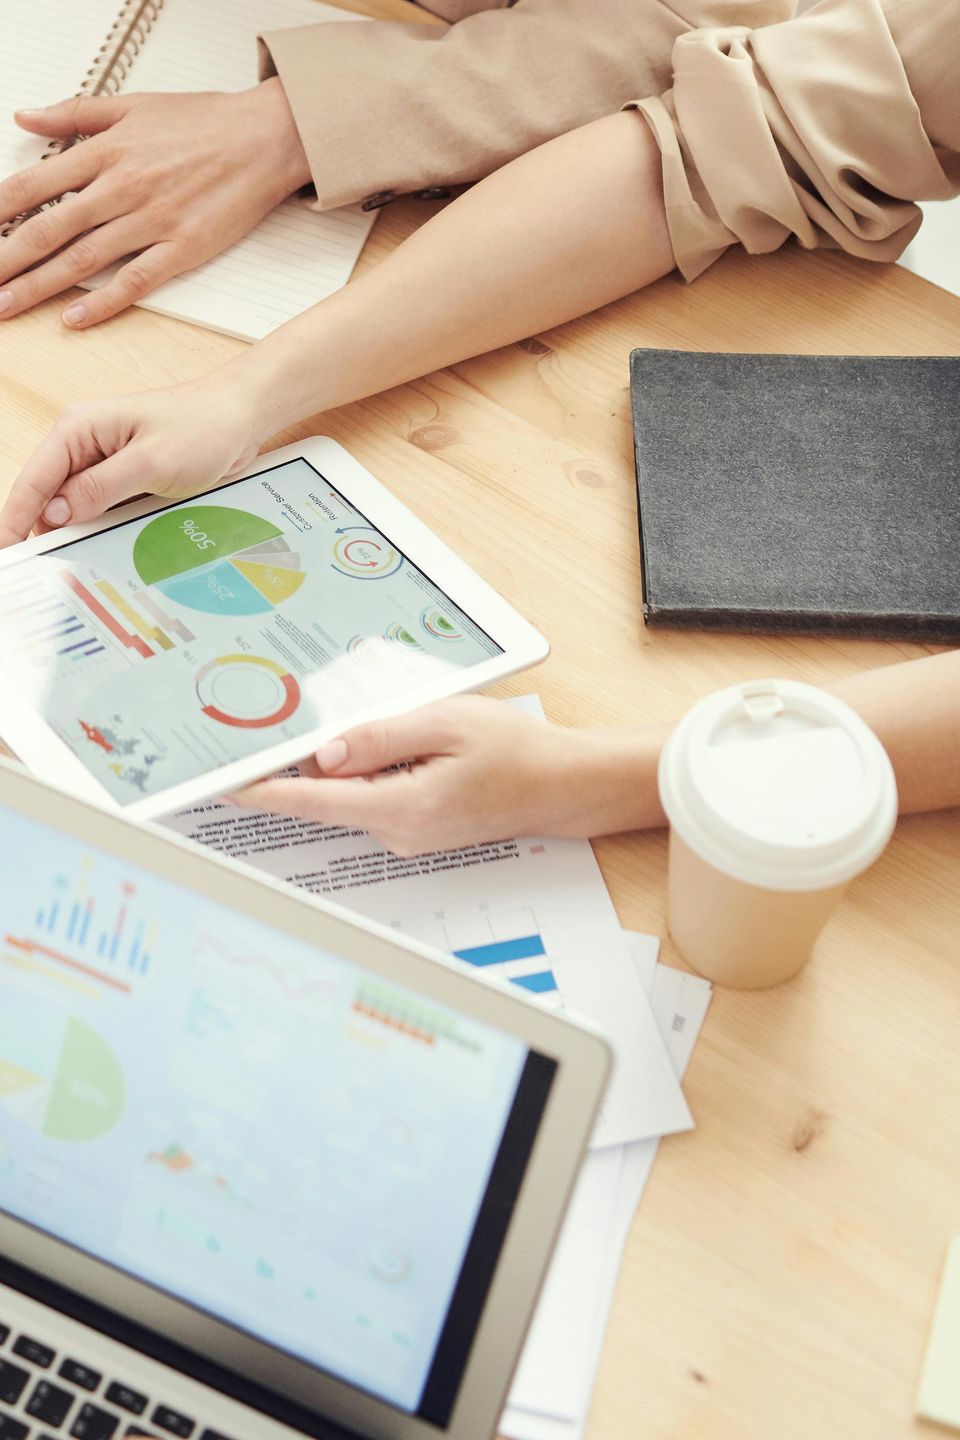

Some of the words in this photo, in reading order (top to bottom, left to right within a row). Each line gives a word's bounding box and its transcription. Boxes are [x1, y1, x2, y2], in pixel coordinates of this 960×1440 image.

[261, 481, 285, 503] Service
[282, 503, 312, 530] Customer
[308, 493, 338, 521] Retention
[179, 520, 216, 550] 50%
[207, 575, 235, 601] 25%
[238, 813, 268, 822] customer
[269, 817, 293, 825] service
[292, 837, 322, 846] customer
[324, 830, 350, 841] percent
